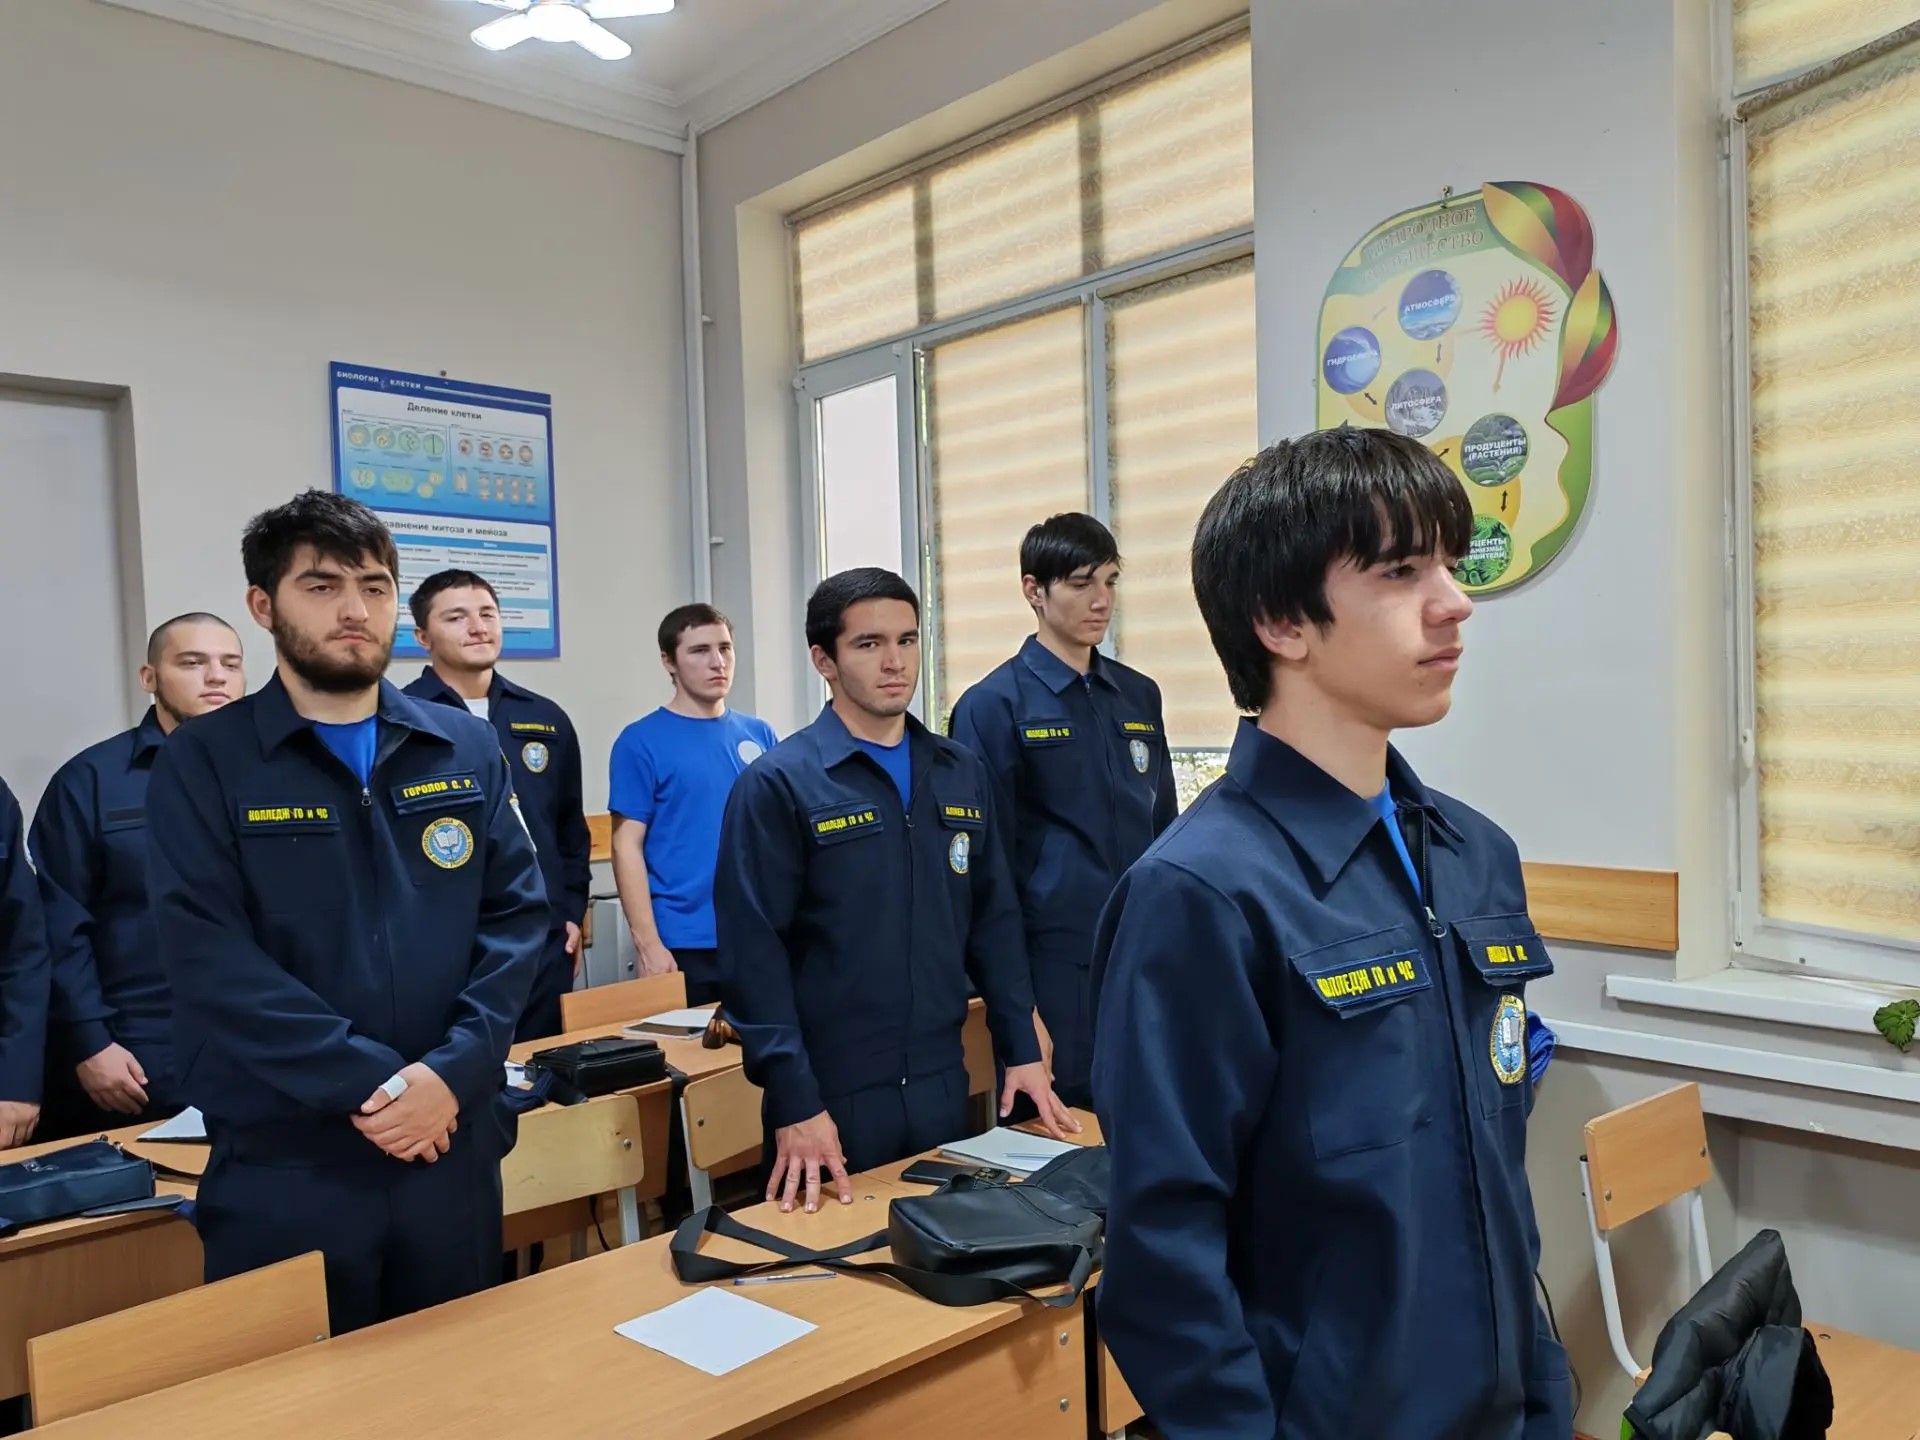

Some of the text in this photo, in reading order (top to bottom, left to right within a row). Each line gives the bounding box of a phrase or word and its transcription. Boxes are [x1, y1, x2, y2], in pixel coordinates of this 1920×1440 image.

[1404, 294, 1457, 313] АТМОСФЕРА
[336, 370, 421, 390] БИОЛОГИЯ КЛЕТКИ
[407, 402, 482, 420] Деление клетки
[1391, 395, 1441, 411] ЛИТОСФЕРА
[1464, 437, 1527, 453] ПРОДУЦЕНТЫ
[1469, 446, 1522, 461] (РАСТЕНИЯ)
[432, 524, 465, 534] митоза
[476, 527, 508, 537] мейоза
[1470, 538, 1507, 548] УЦЕНТЫ
[451, 779, 462, 790] С.
[464, 778, 474, 788] Р.
[248, 808, 328, 822] КОЛЛЕДЖ ГО и ЧС
[817, 817, 848, 832] КОЛЛЕДЖ
[848, 815, 856, 826] ГО
[864, 812, 874, 822] ЧС
[1396, 960, 1415, 981] ЧС
